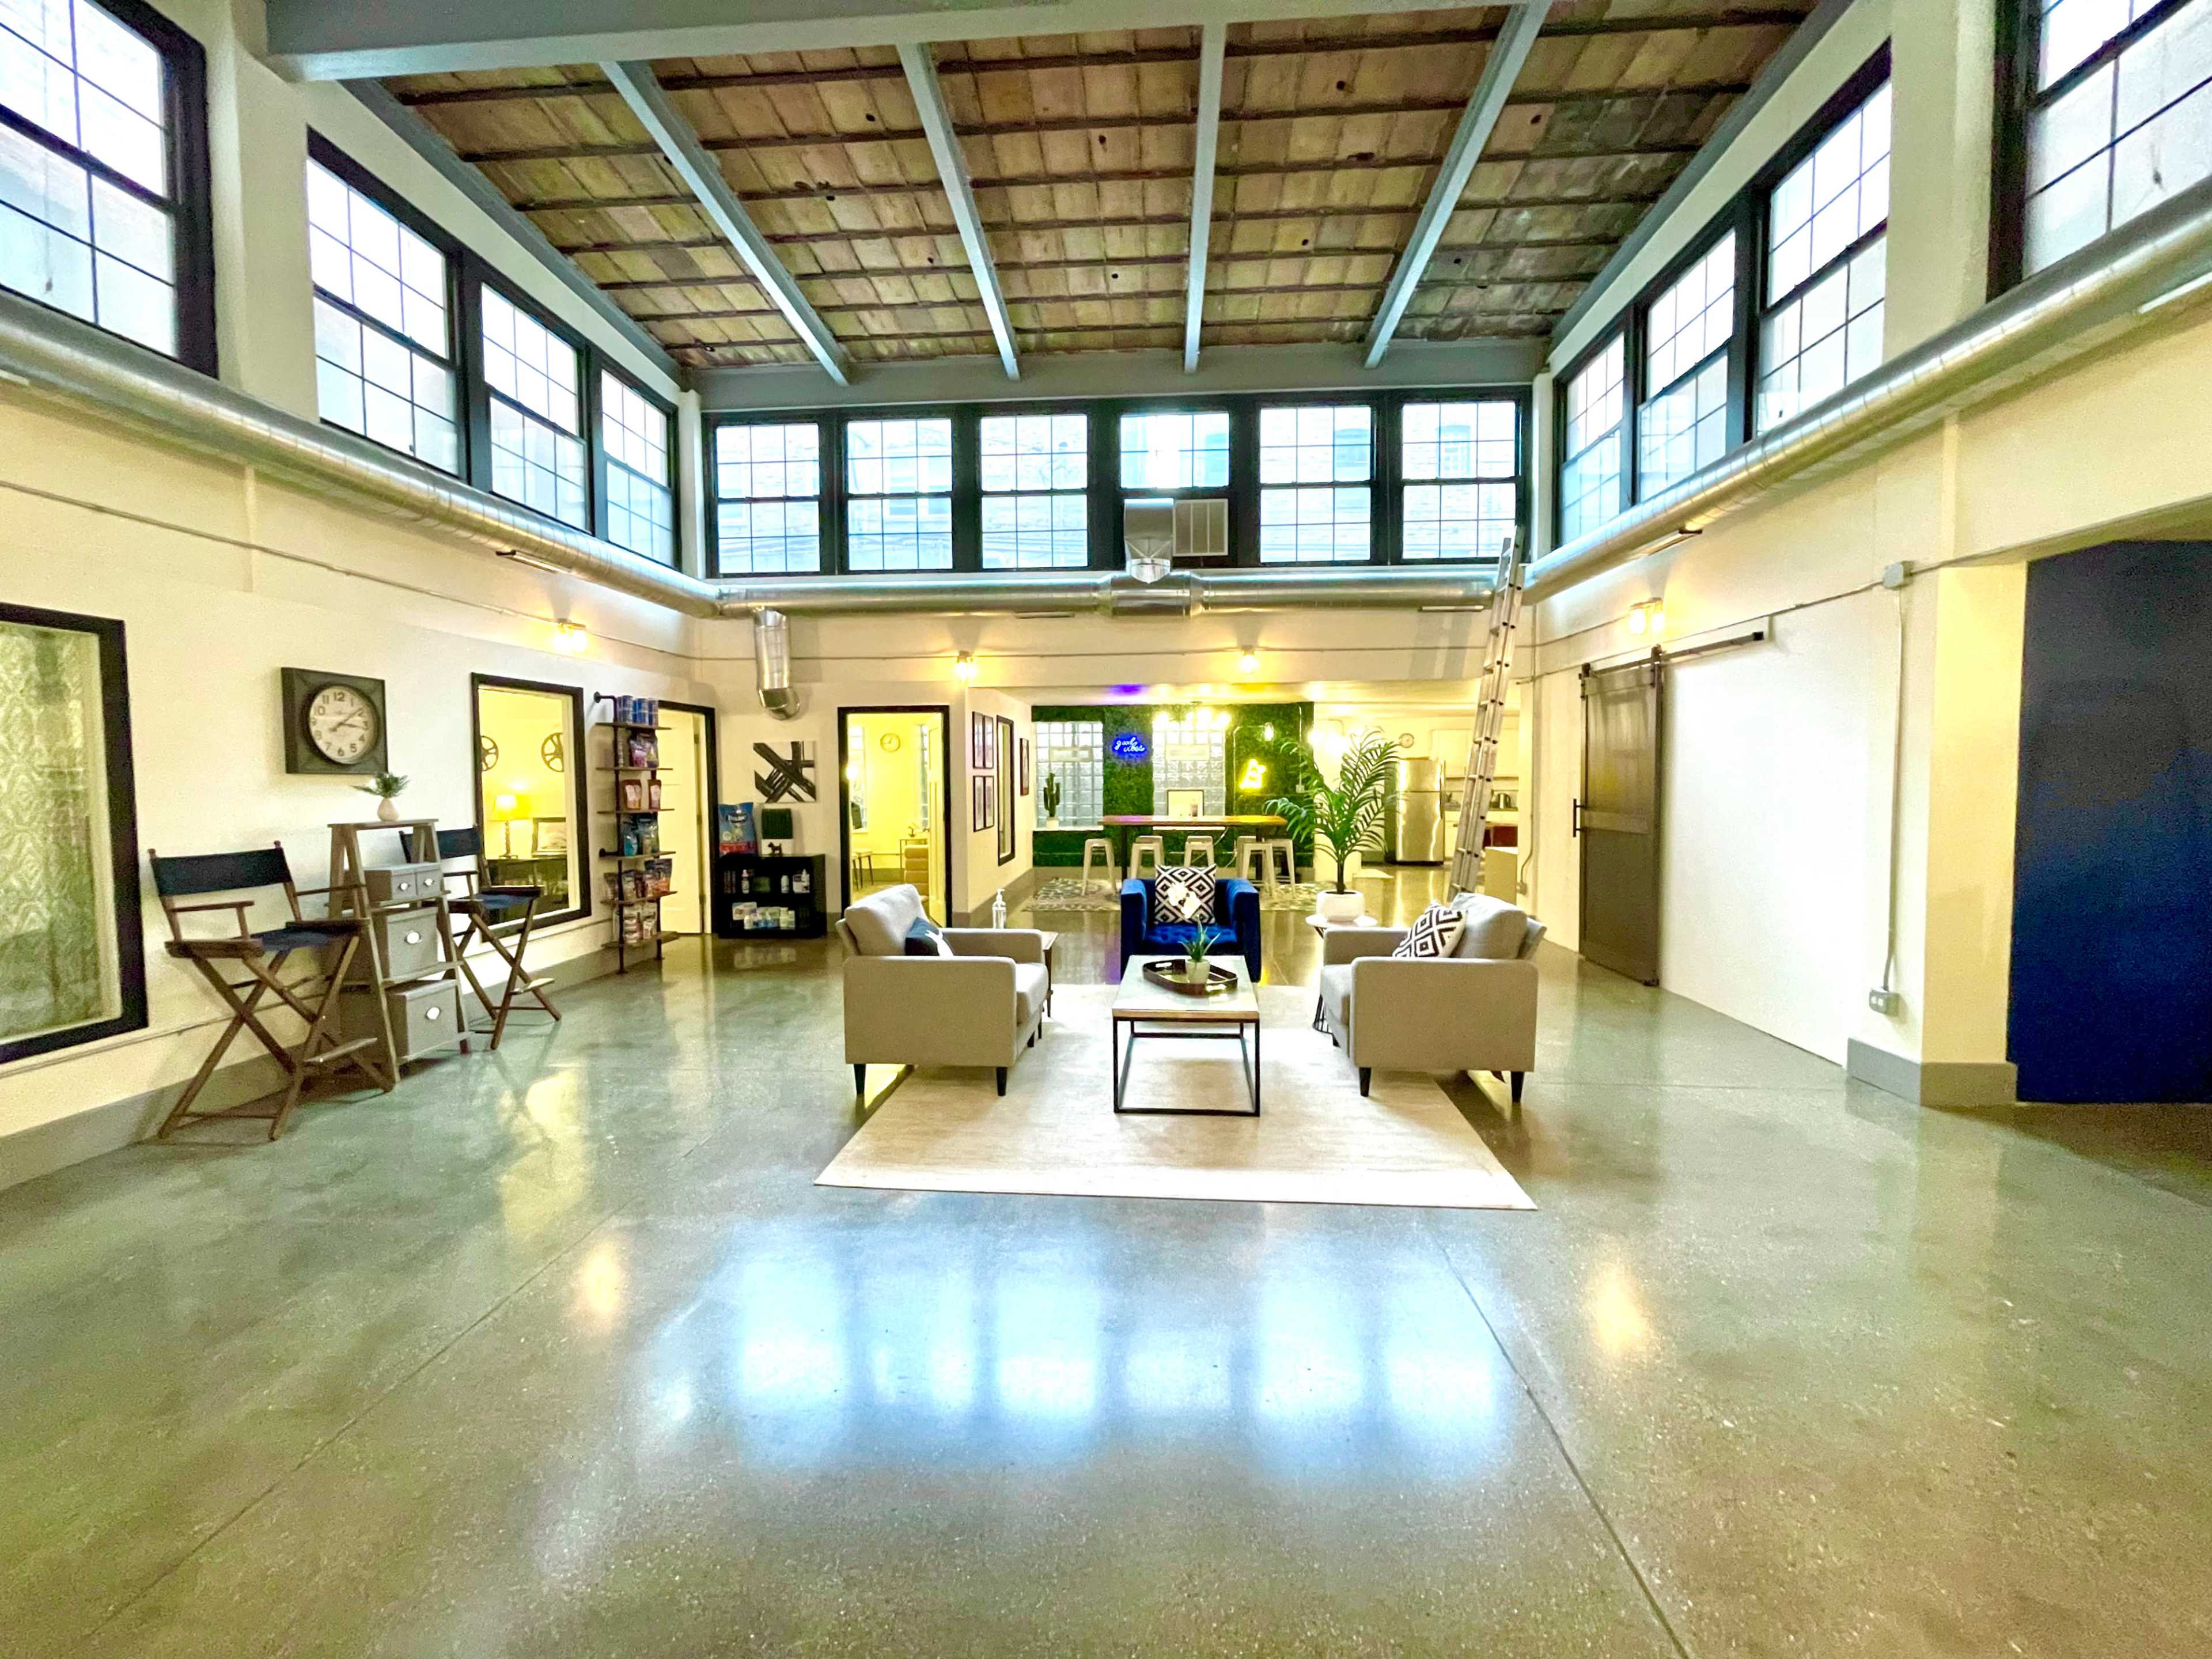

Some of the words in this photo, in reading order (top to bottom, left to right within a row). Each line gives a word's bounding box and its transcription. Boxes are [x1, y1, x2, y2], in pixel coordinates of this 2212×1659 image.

[323, 695, 329, 704] 11
[334, 691, 345, 702] 12
[350, 697, 354, 707] 1
[315, 706, 325, 715] 10
[358, 733, 365, 743] 4
[324, 741, 332, 751] 7
[350, 743, 357, 753] 5
[1115, 737, 1136, 750] good
[1123, 741, 1145, 752] vibes
[337, 747, 344, 756] 6
